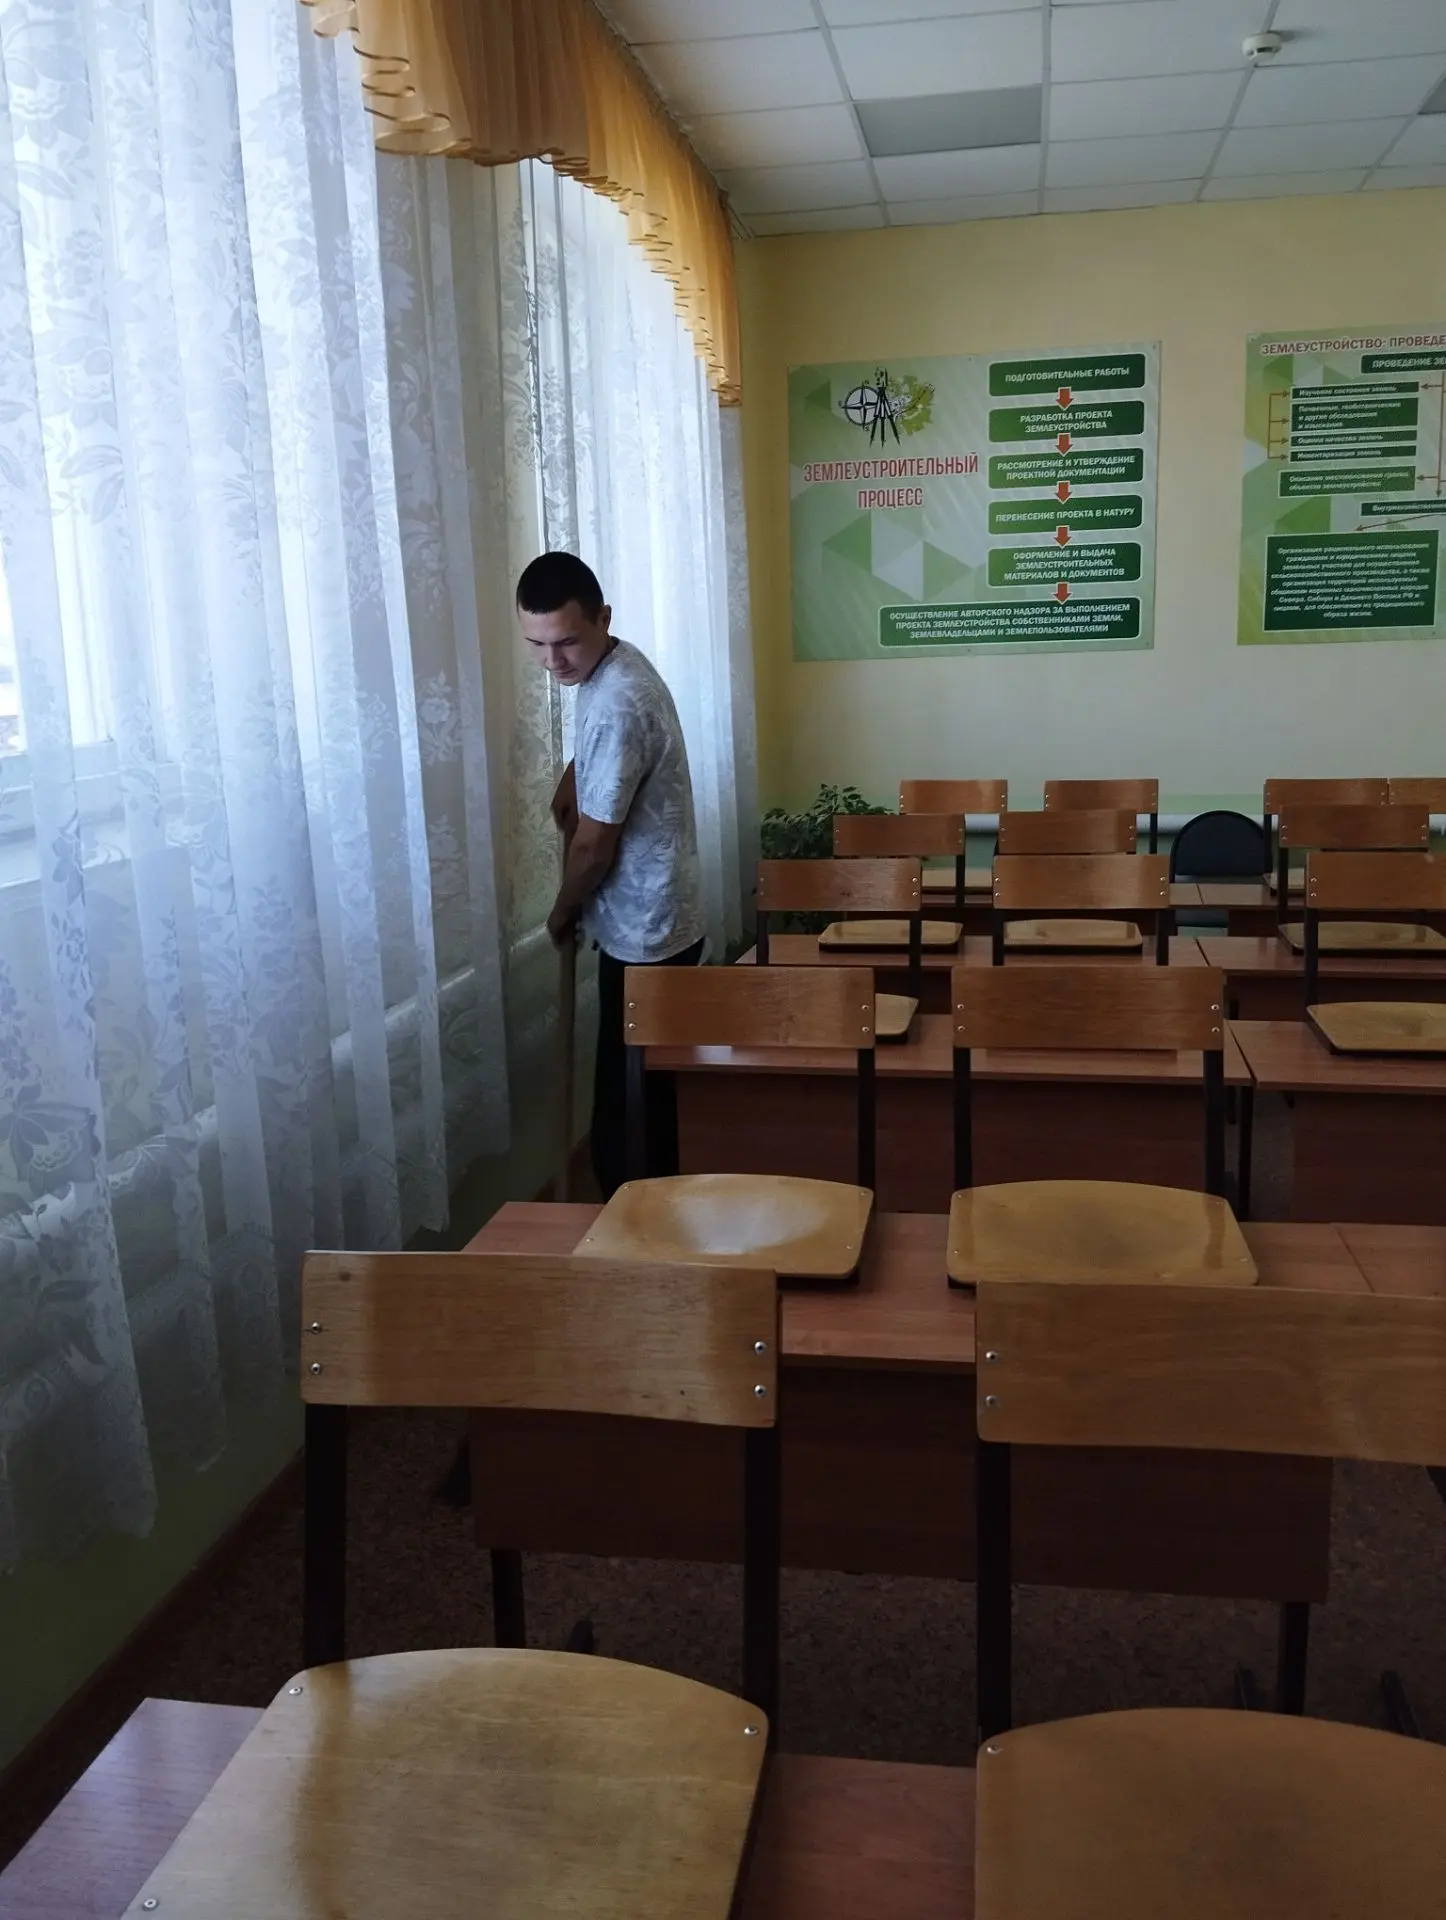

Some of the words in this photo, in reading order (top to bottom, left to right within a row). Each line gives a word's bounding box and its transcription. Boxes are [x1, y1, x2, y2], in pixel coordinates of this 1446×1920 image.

[1372, 358, 1432, 369] ПРОВЕДЕНИЕ
[1005, 369, 1092, 382] ПОДГОТОВИТЕЛЬНЫЕ
[1094, 367, 1130, 376] РАБОТЫ
[1020, 413, 1073, 423] РАЗРАБОТКА
[1075, 410, 1112, 419] ПРОЕКТА
[1025, 421, 1107, 433] ЗЕМЛЕУСТРОЙСТВА
[803, 452, 979, 482] ЗЕМЛЕУСТРОИТЕЛЬНЫЙ
[997, 459, 1064, 470] РАССМОТРЕНИЕ
[1066, 459, 1072, 467] И
[1073, 456, 1135, 466] УТВЕРЖДЕНИЕ
[1006, 469, 1056, 480] ПРОЕКТНОЙ
[1057, 466, 1126, 478] ДОКУМЕНТАЦИИ
[858, 487, 923, 509] ПРОЦЕСС
[996, 511, 1055, 522] ПЕРЕНЕСЕНИЕ
[1057, 510, 1094, 519] ПРОЕКТА
[1095, 509, 1101, 517] В
[1103, 507, 1135, 516] НАТУРУ
[1013, 550, 1071, 560] ОФОРМЛЕНИЕ
[1081, 548, 1116, 557] ВЫДАЧА
[1015, 558, 1113, 570] ЗЕМЛЕУСТРОИТЕЛЬНЫХ
[1004, 571, 1059, 580] МАТЕРИАЛОВ
[1068, 568, 1125, 579] ДОКУМЕНТОВ
[890, 610, 959, 621] ОСУЩЕСТВЛЕНИЕ
[960, 608, 1012, 617] АВТОРСКОГО
[1013, 607, 1051, 616] НАДЗОРА
[1052, 606, 1063, 614] ЗА
[1065, 603, 1130, 614] ВЫПОЛНЕНИЕМ
[896, 621, 931, 630] ПРОЕКТА
[933, 617, 1011, 628] ЗЕМЛЕУСТРОЙСТВА
[1012, 615, 1090, 625] СОБСТВЕННИКАМИ
[910, 628, 996, 639] ЗЕМЛЕВЛАДЕЛЬЦАМИ
[1006, 624, 1109, 635] ЗЕМЛЕПОЛЬЗОВАТЕЛЯМИ
